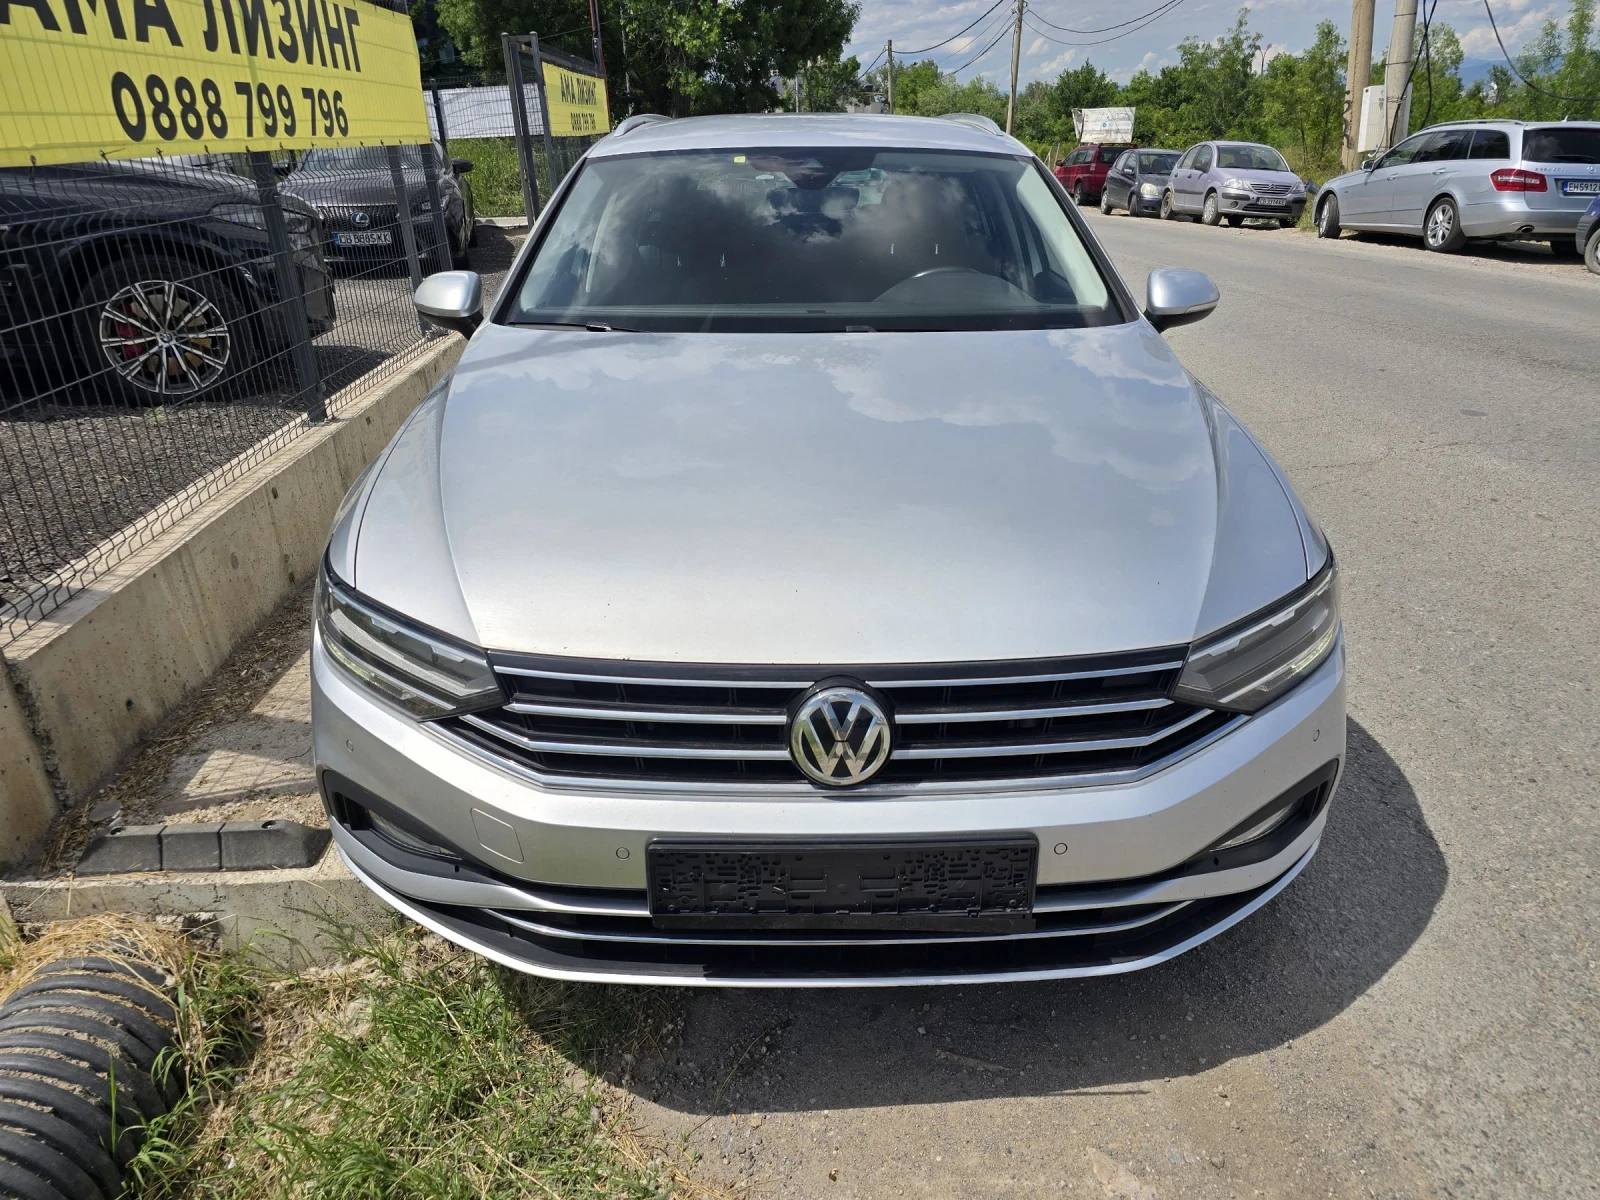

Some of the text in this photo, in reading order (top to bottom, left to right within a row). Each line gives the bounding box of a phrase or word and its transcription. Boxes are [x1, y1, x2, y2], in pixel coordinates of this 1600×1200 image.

[0, 0, 362, 73] МА ЛИЗИНГ
[111, 71, 350, 143] 0888 799 796
